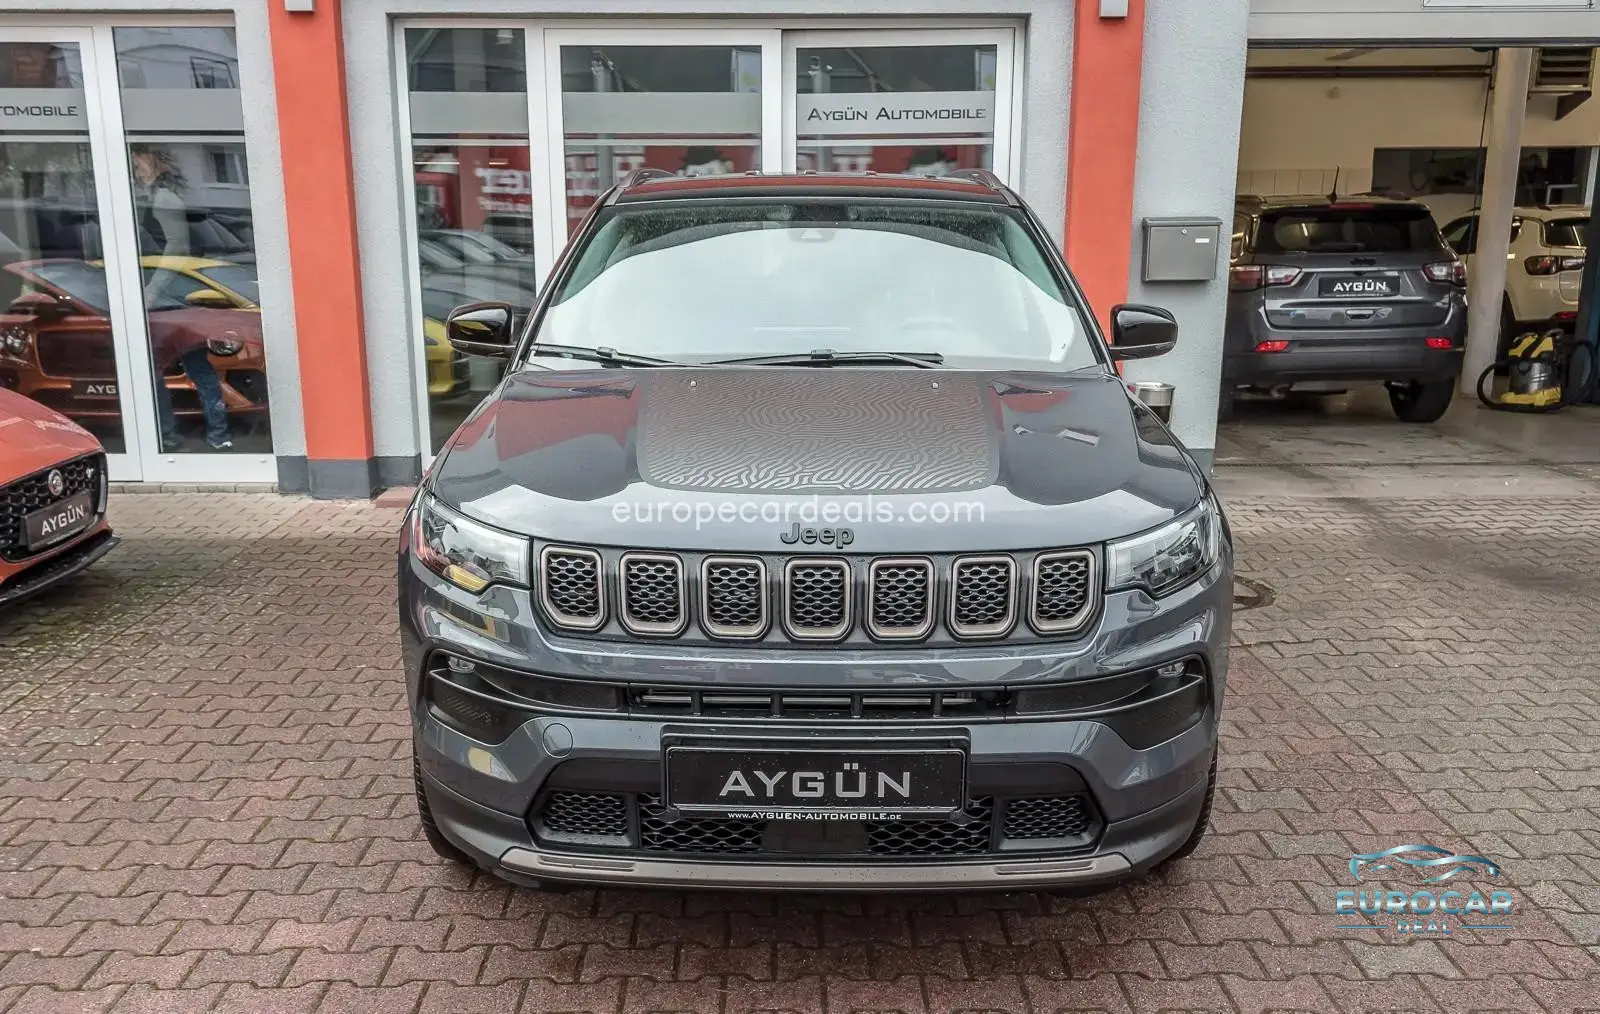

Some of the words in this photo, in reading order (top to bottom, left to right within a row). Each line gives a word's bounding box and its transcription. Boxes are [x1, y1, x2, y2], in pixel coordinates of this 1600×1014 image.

[807, 107, 868, 121] AYGÜN
[875, 107, 987, 121] AUTOMOBILE
[1333, 279, 1387, 292] AYGÜN
[41, 504, 84, 536] AYGÜN
[780, 522, 855, 548] Jeep
[719, 762, 911, 799] AYGÜN
